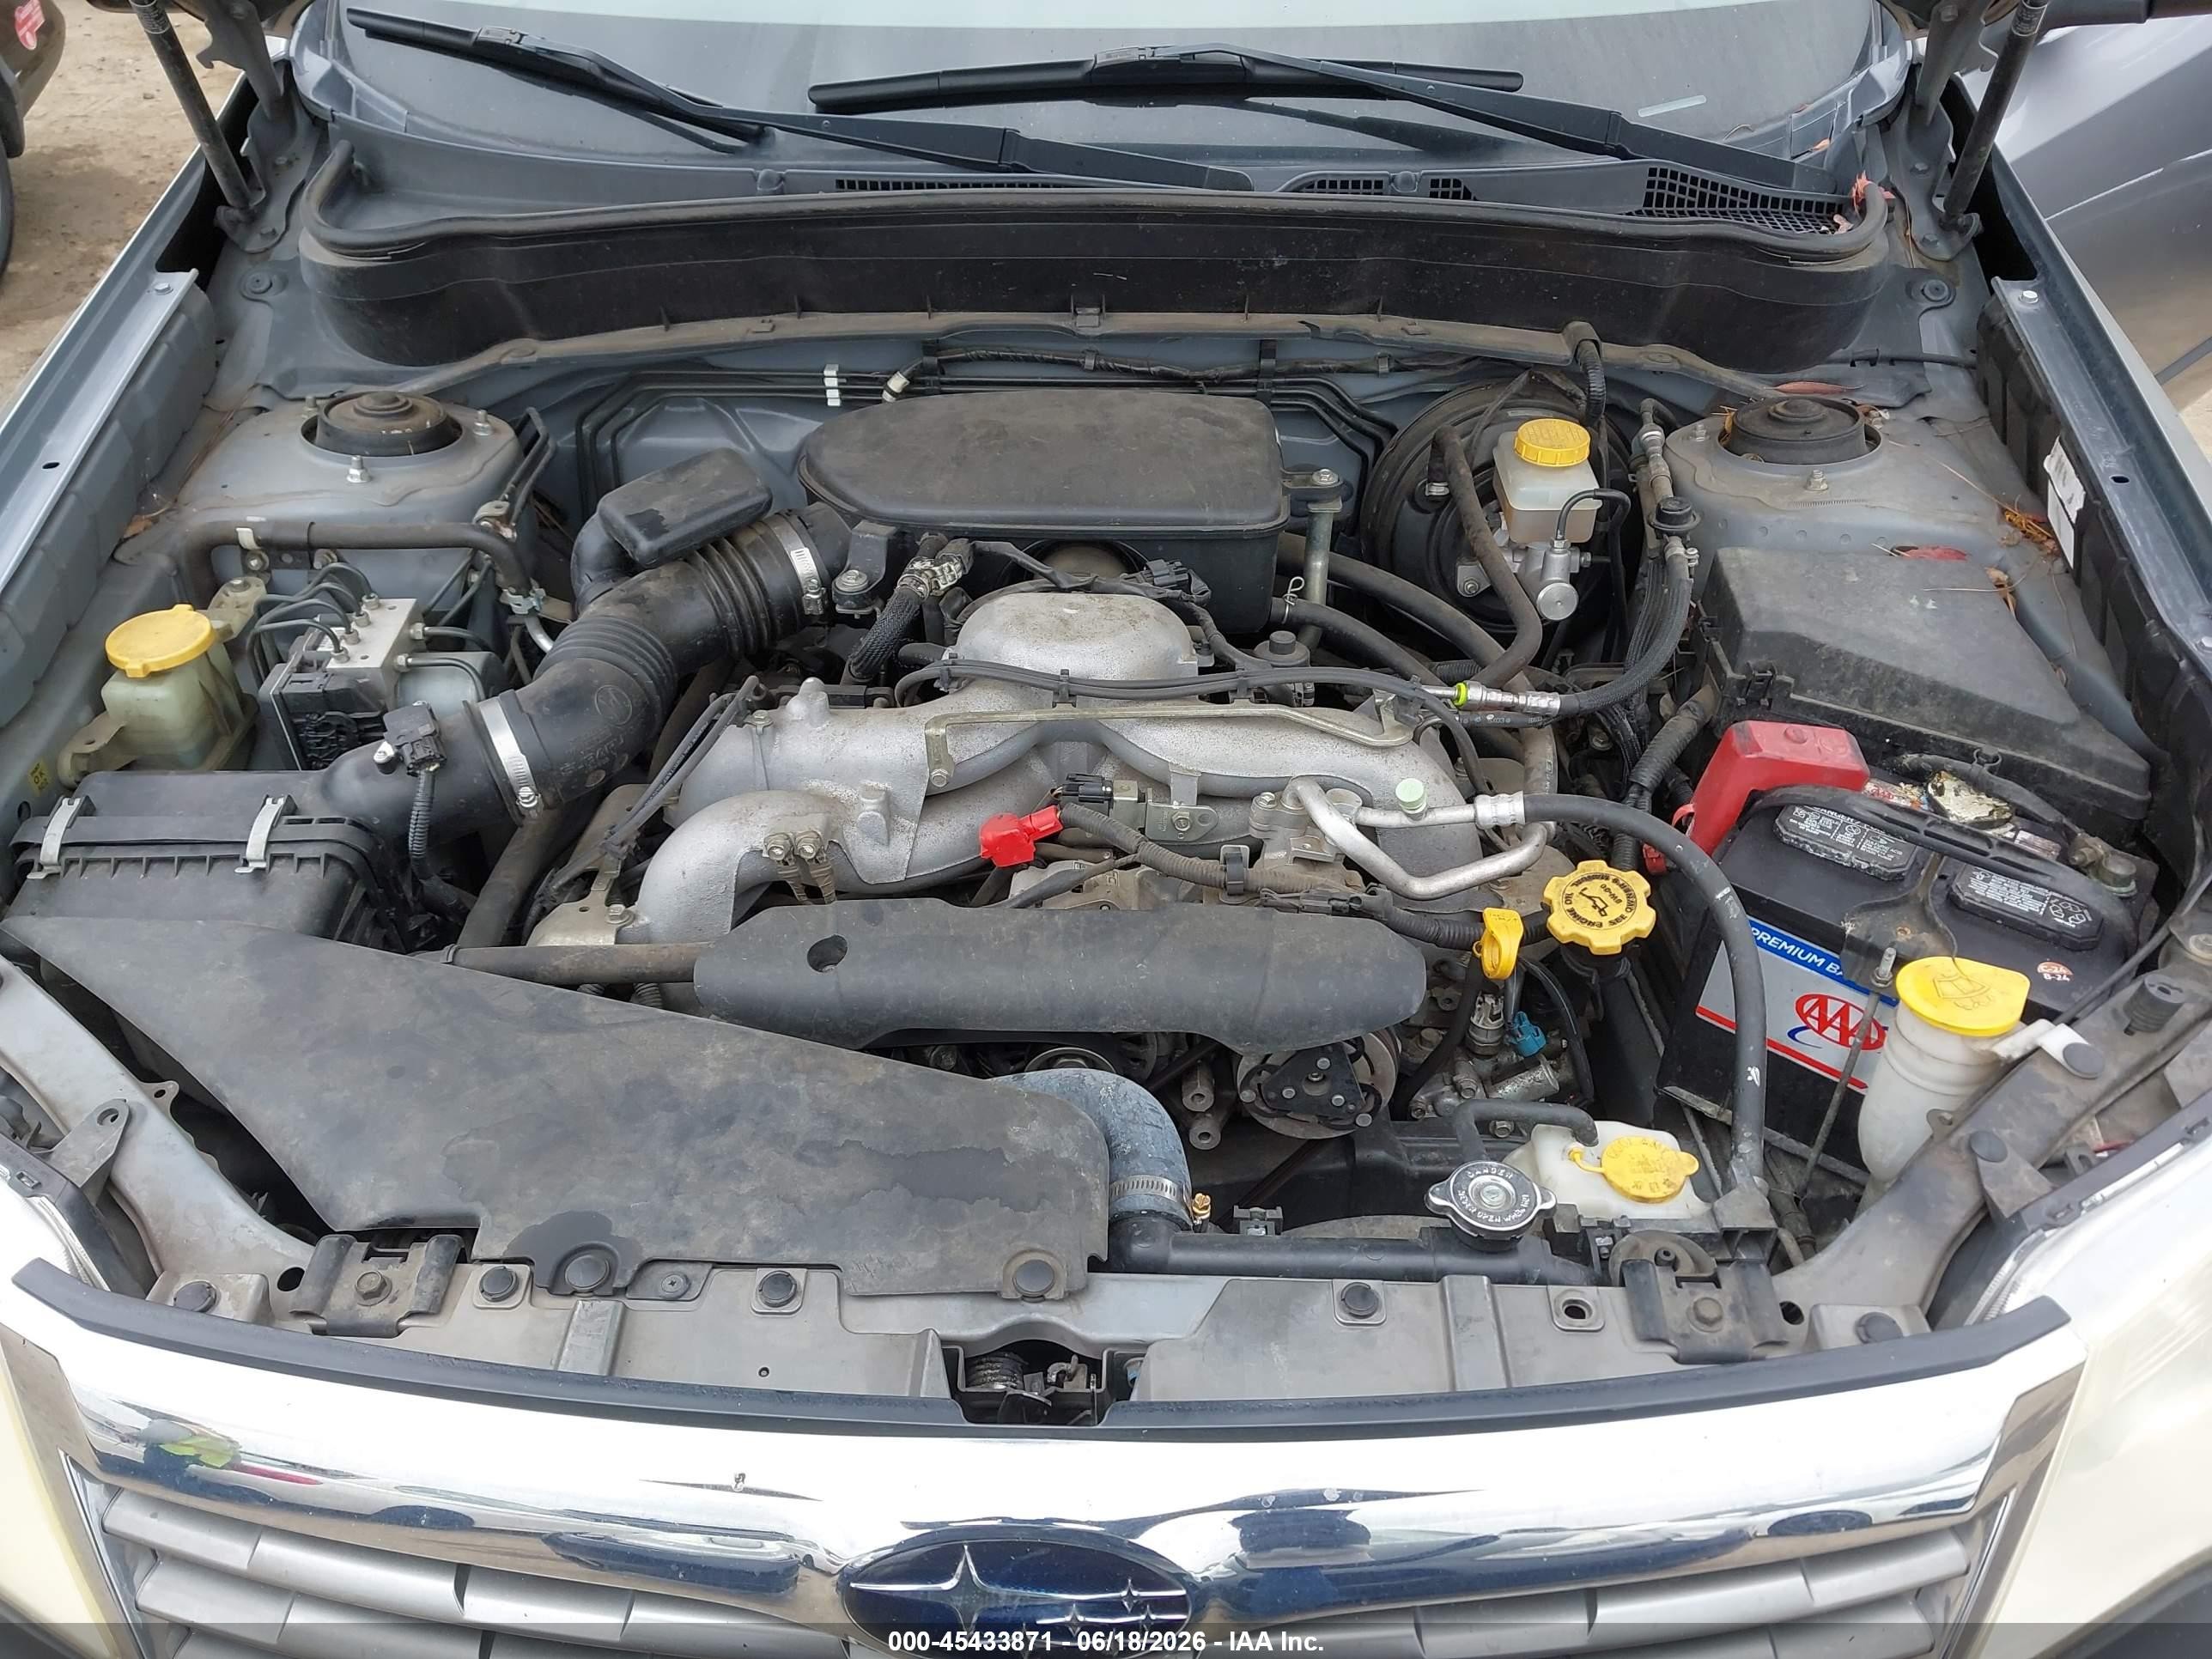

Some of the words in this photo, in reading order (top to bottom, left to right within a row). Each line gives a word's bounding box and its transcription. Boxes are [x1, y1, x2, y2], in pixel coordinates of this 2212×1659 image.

[1566, 907, 1603, 928] ENGINE
[1752, 927, 1826, 968] PREMIUM
[1796, 994, 1887, 1050] AAA
